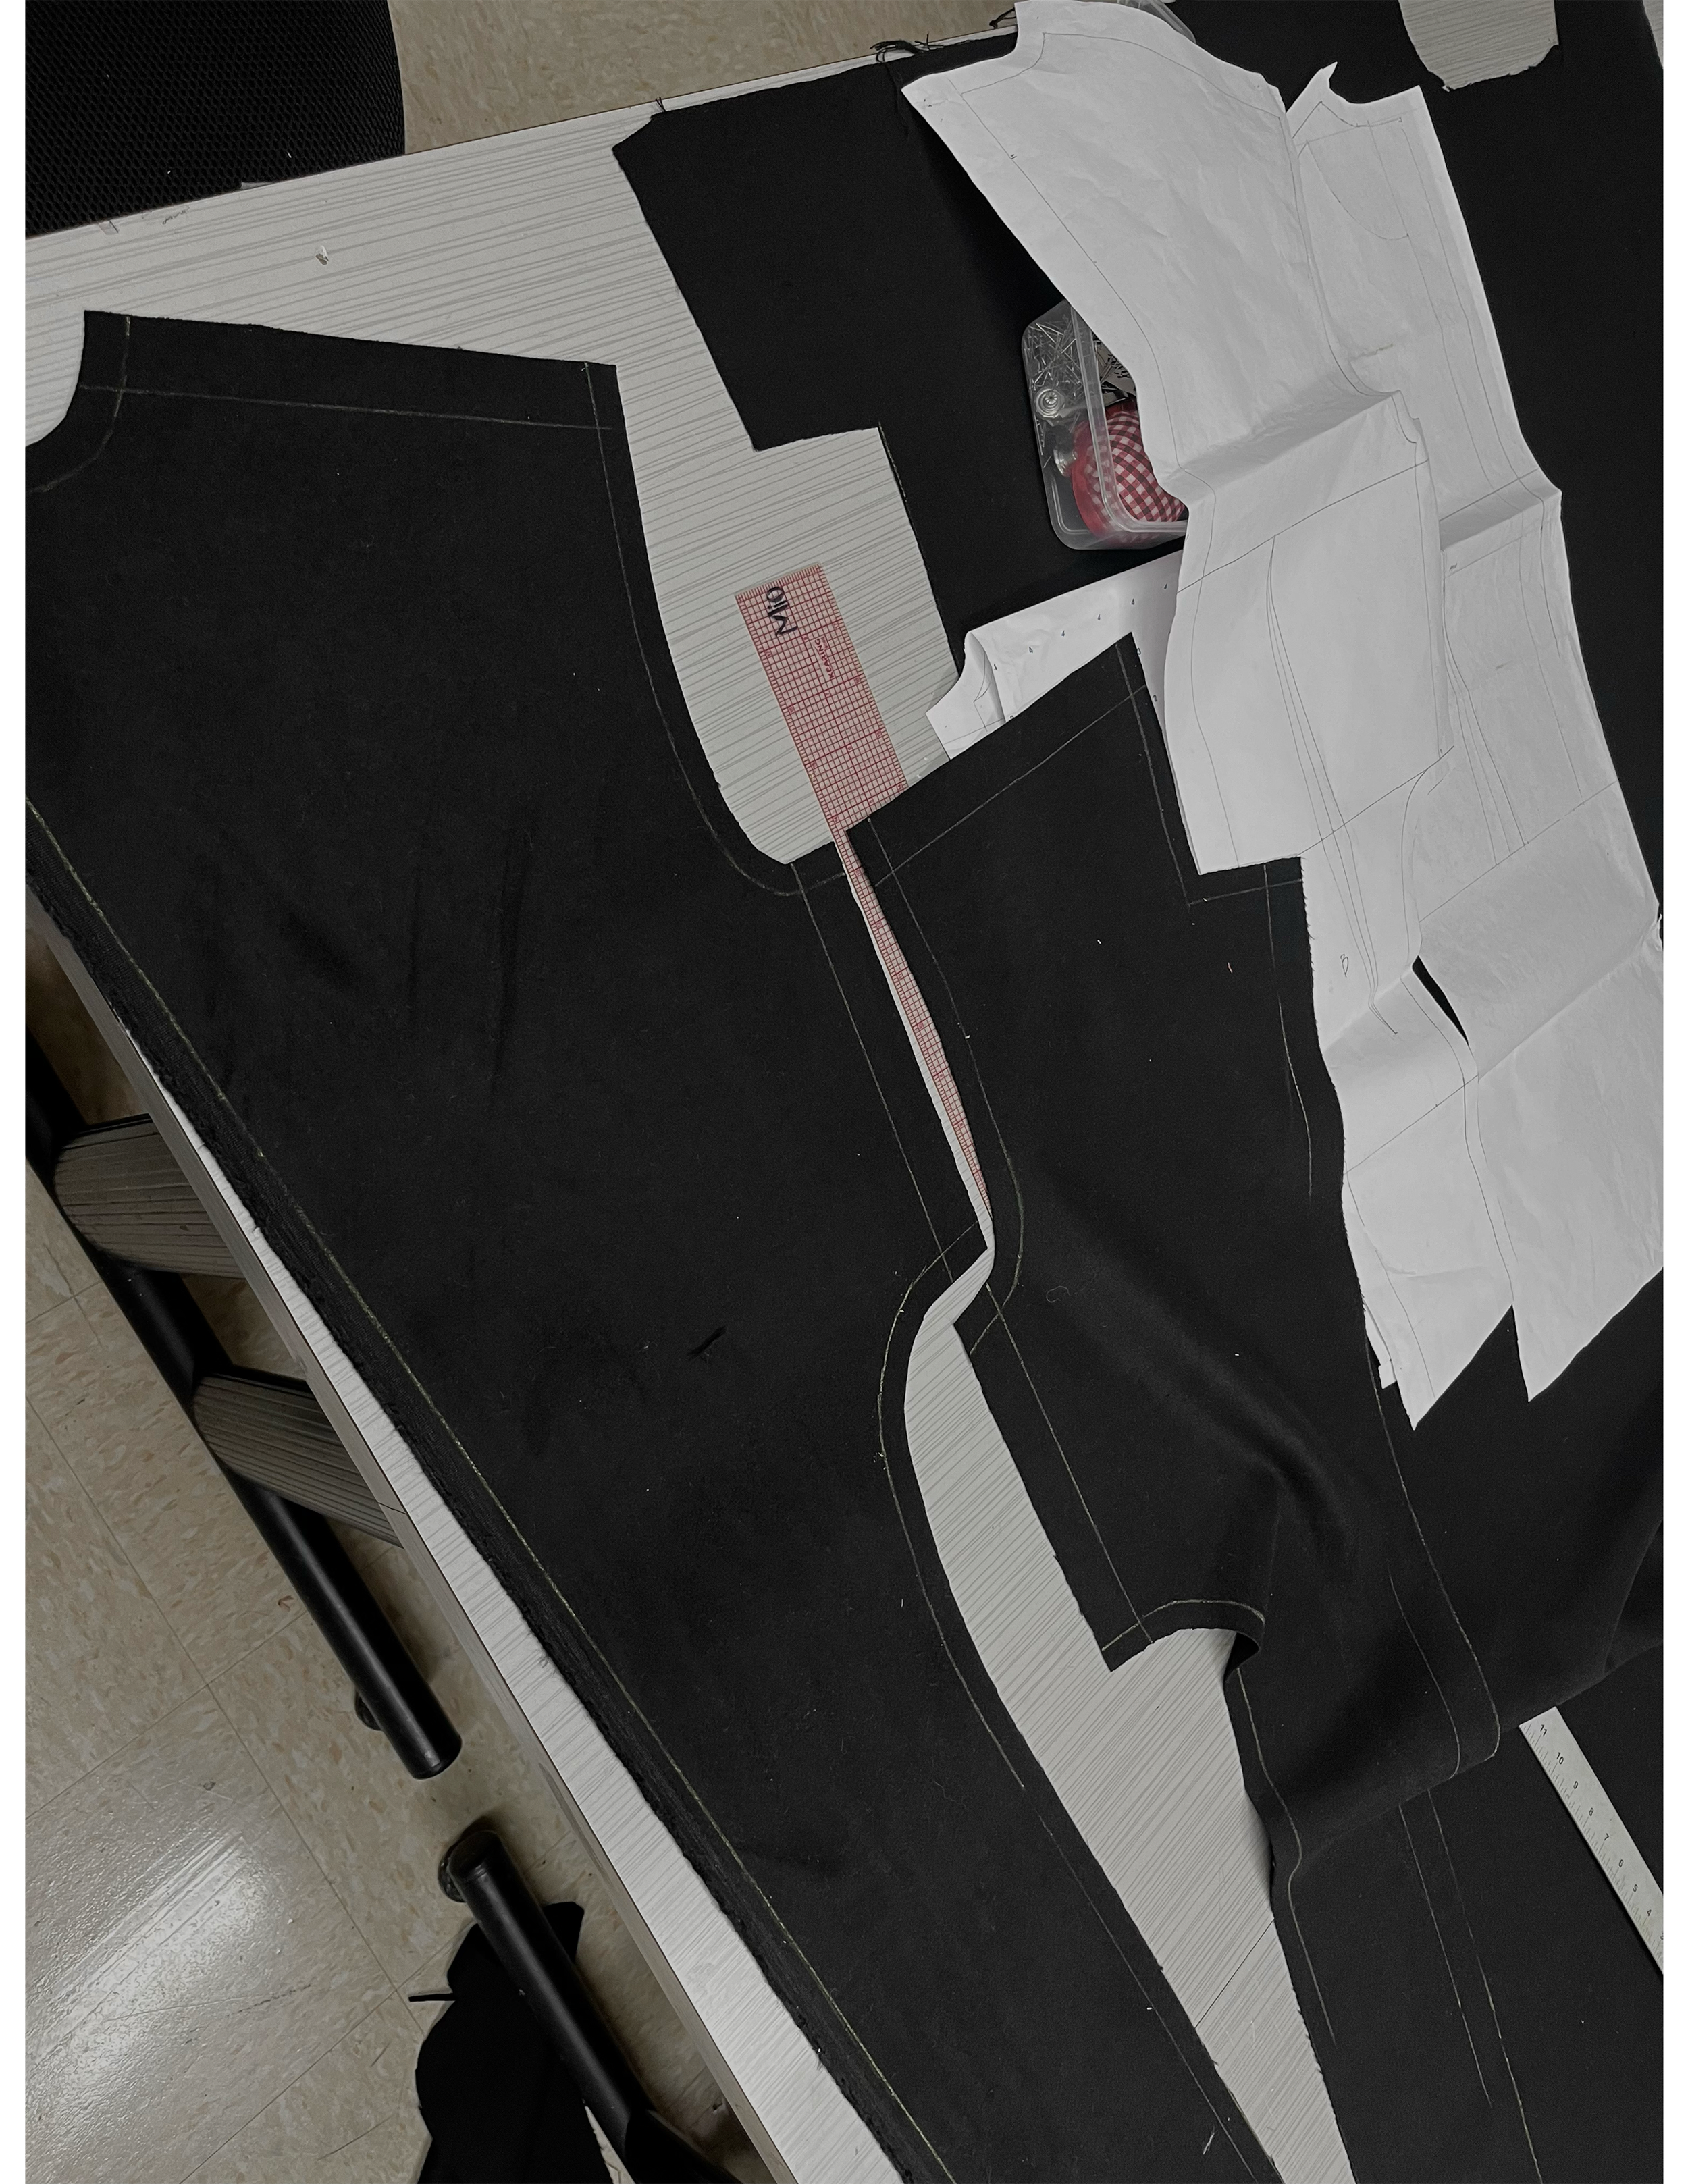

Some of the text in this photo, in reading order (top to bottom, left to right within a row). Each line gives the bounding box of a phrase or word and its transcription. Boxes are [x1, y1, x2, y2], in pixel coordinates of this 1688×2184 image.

[814, 639, 835, 679] KEARING
[1540, 1724, 1547, 1736] 11
[1556, 1752, 1564, 1765] 10
[1573, 1780, 1579, 1789] 9
[1588, 1807, 1594, 1816] 8
[1604, 1833, 1610, 1841] 7
[1618, 1859, 1624, 1867] 6
[1633, 1884, 1638, 1892] 5
